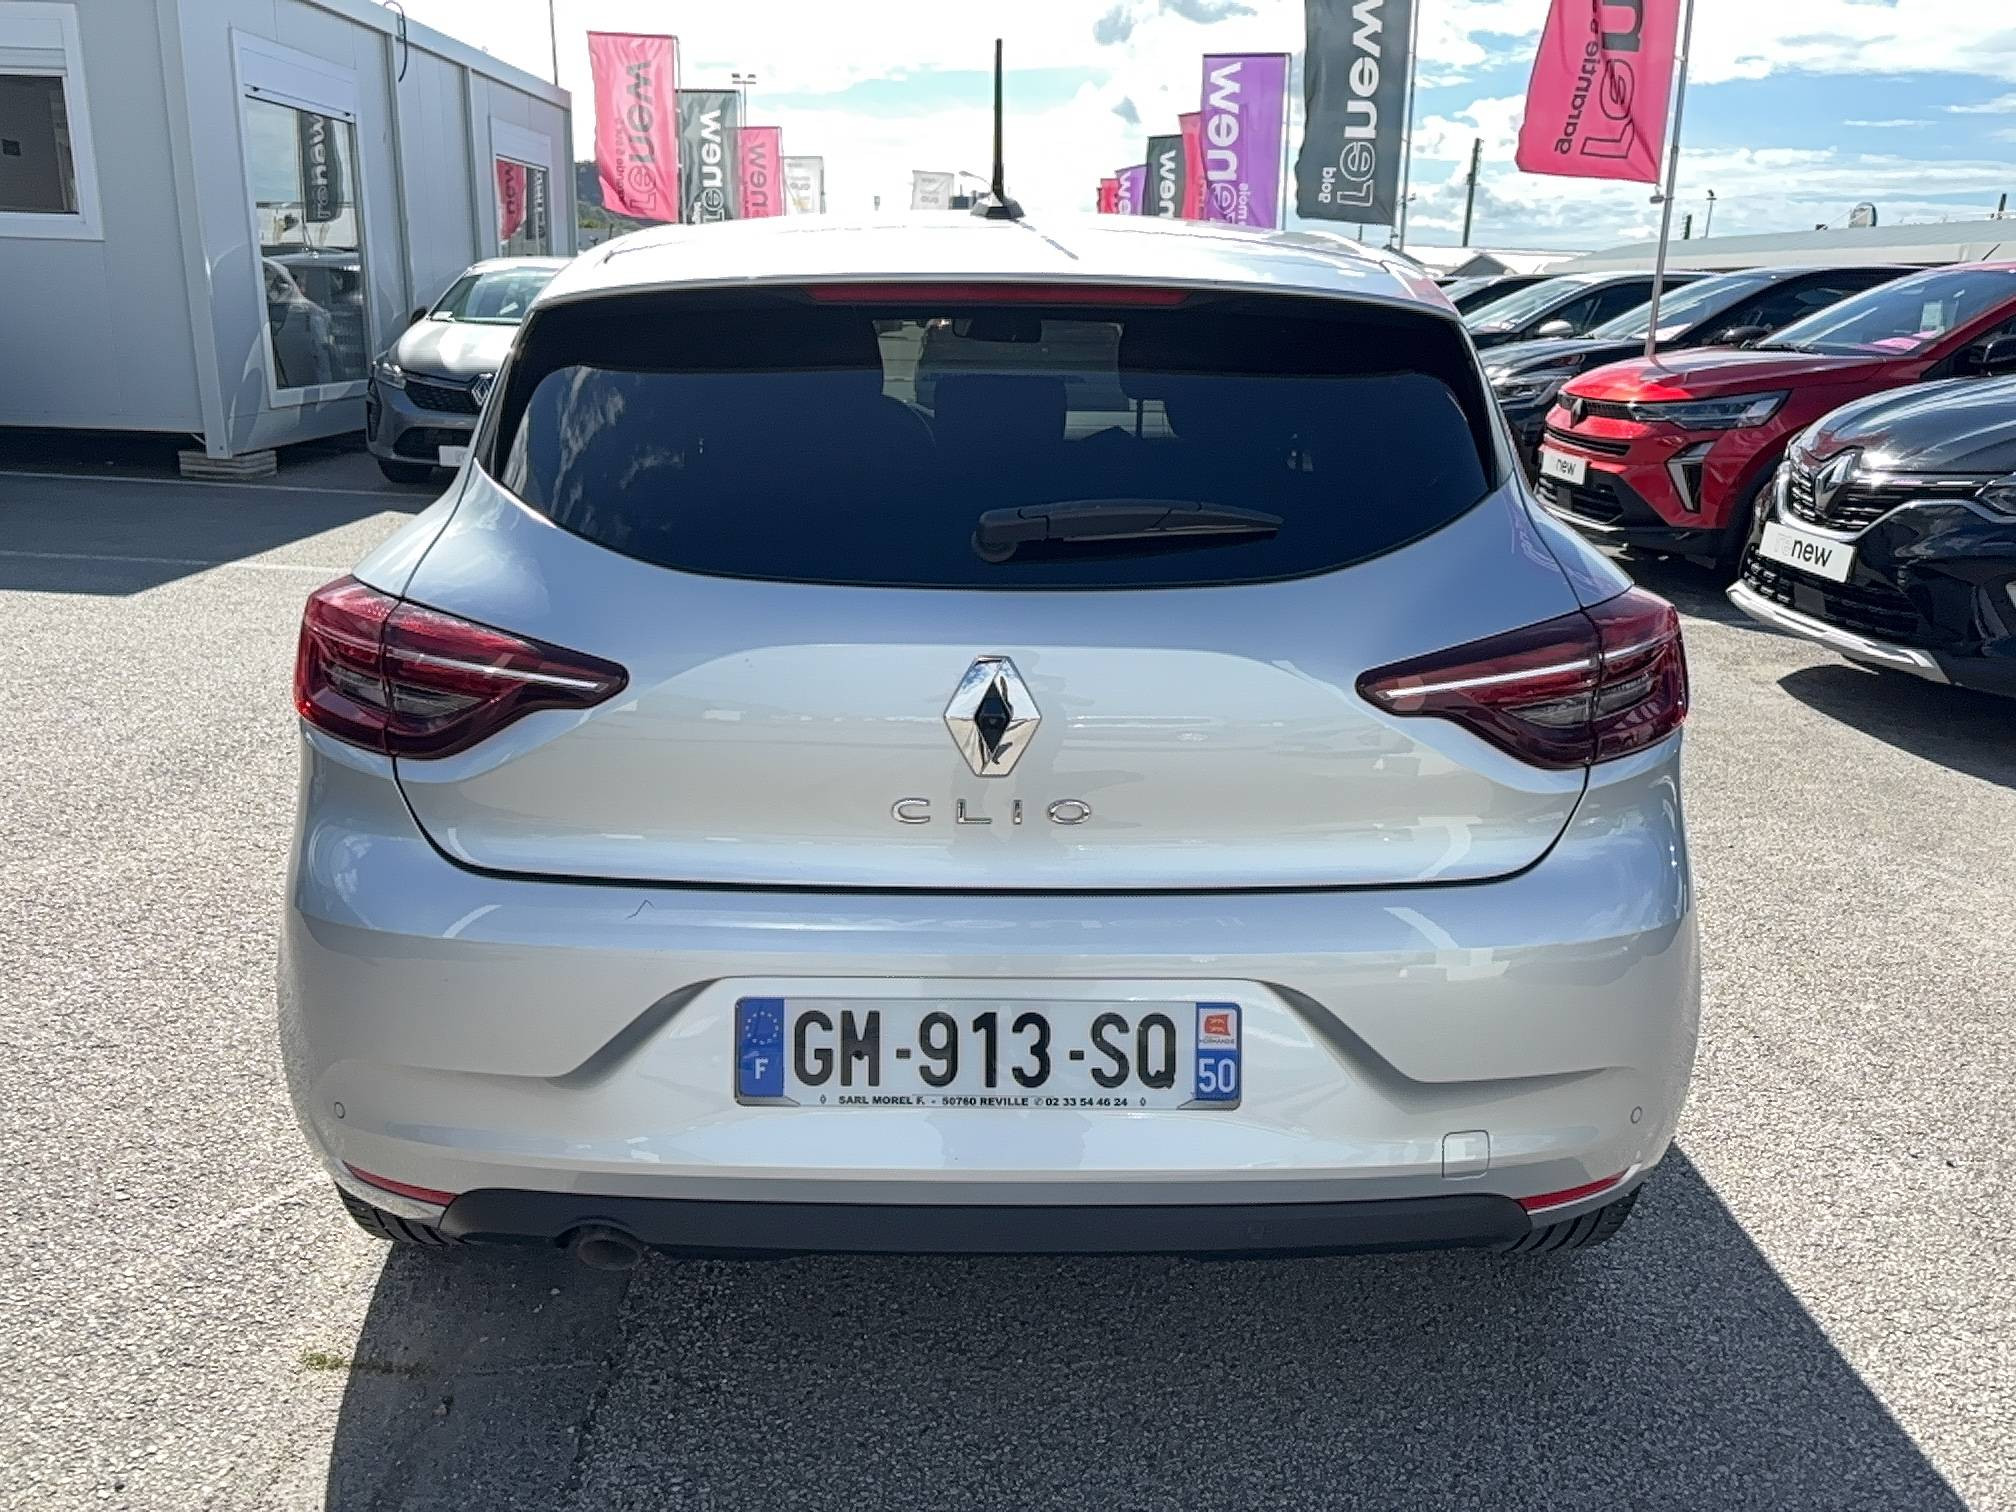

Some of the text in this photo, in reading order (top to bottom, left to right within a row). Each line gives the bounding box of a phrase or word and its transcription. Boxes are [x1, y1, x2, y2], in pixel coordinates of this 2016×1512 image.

[891, 797, 1091, 825] CLIO
[794, 1010, 1176, 1089] GM-913-SQ
[754, 1058, 769, 1080] F
[1198, 1058, 1236, 1093] 50
[838, 1095, 869, 1105] SARL
[872, 1095, 913, 1105] MOREL
[980, 1096, 1029, 1107] REVILLE
[1045, 1097, 1059, 1106] 02
[1063, 1097, 1077, 1107] 33
[1113, 1097, 1128, 1107] 24
